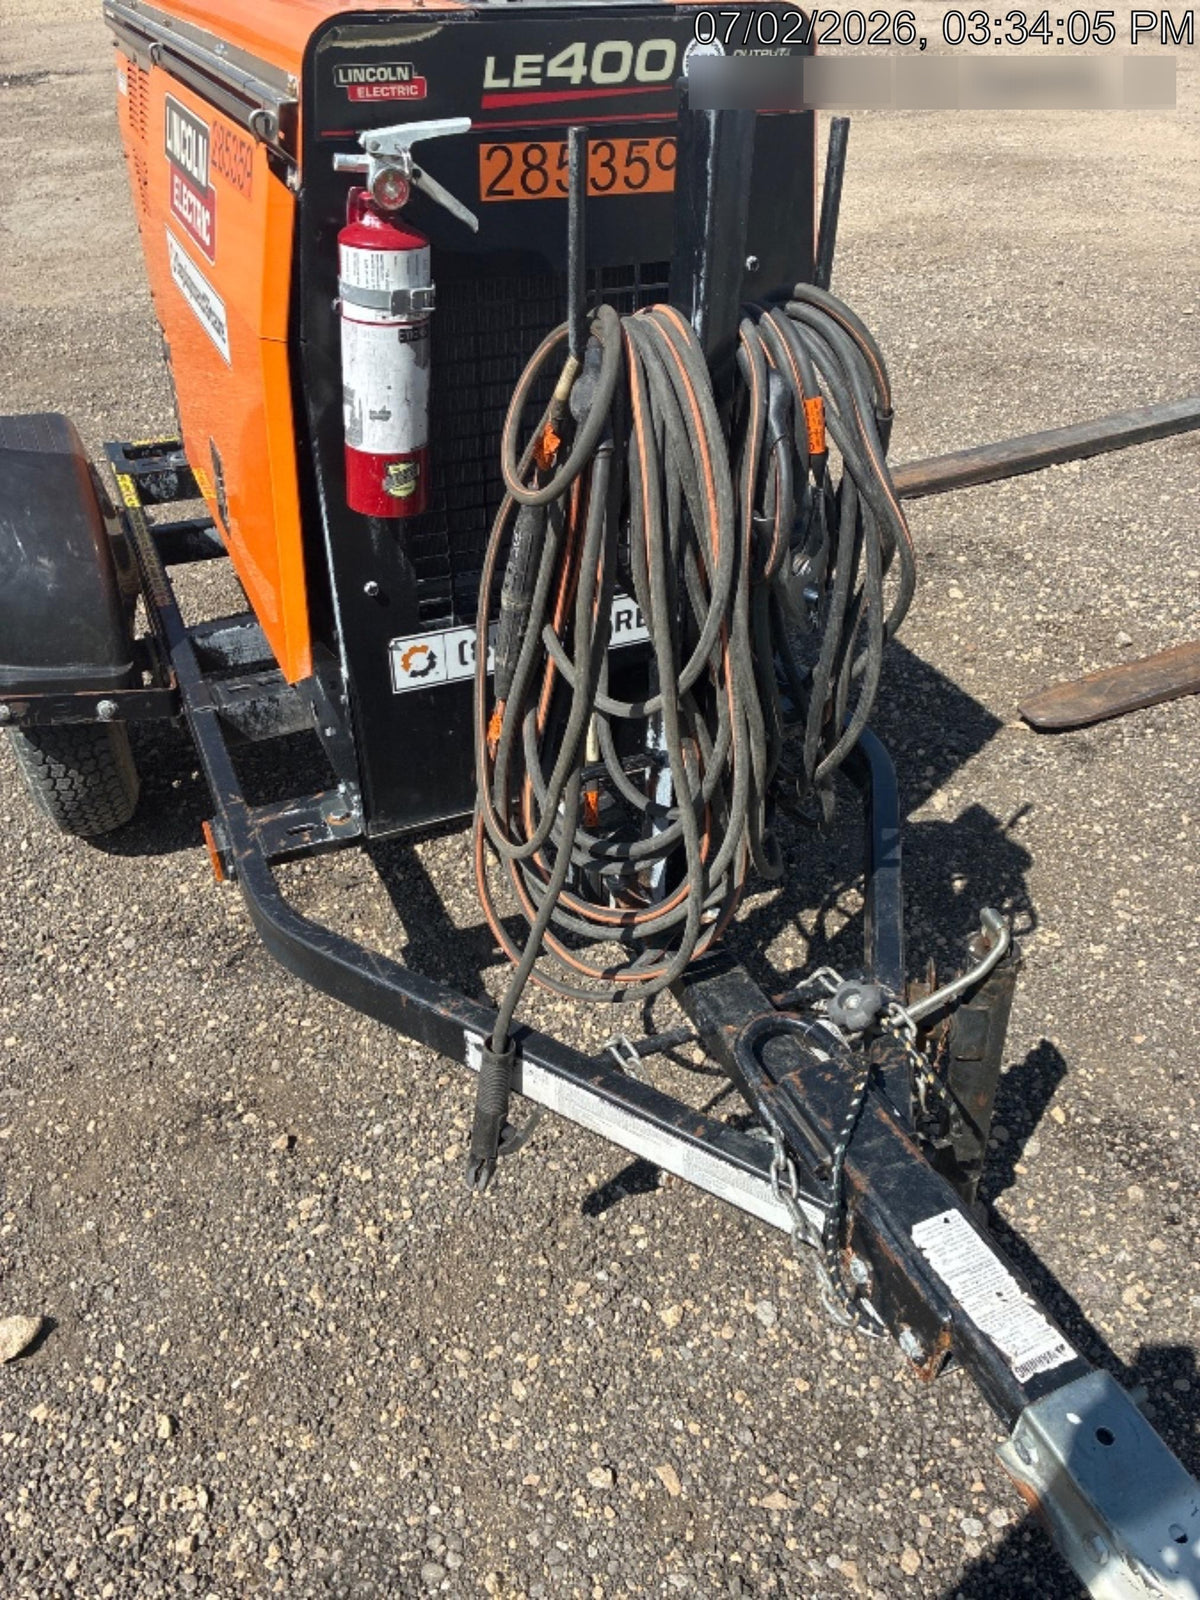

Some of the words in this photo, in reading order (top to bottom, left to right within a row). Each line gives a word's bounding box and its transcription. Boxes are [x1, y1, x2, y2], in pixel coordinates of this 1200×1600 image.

[338, 66, 410, 84] LINCOLN
[483, 38, 677, 89] LE400
[357, 84, 419, 98] ELECTRIC
[166, 105, 207, 188] LINCOLN
[173, 173, 211, 247] ELECTRIC
